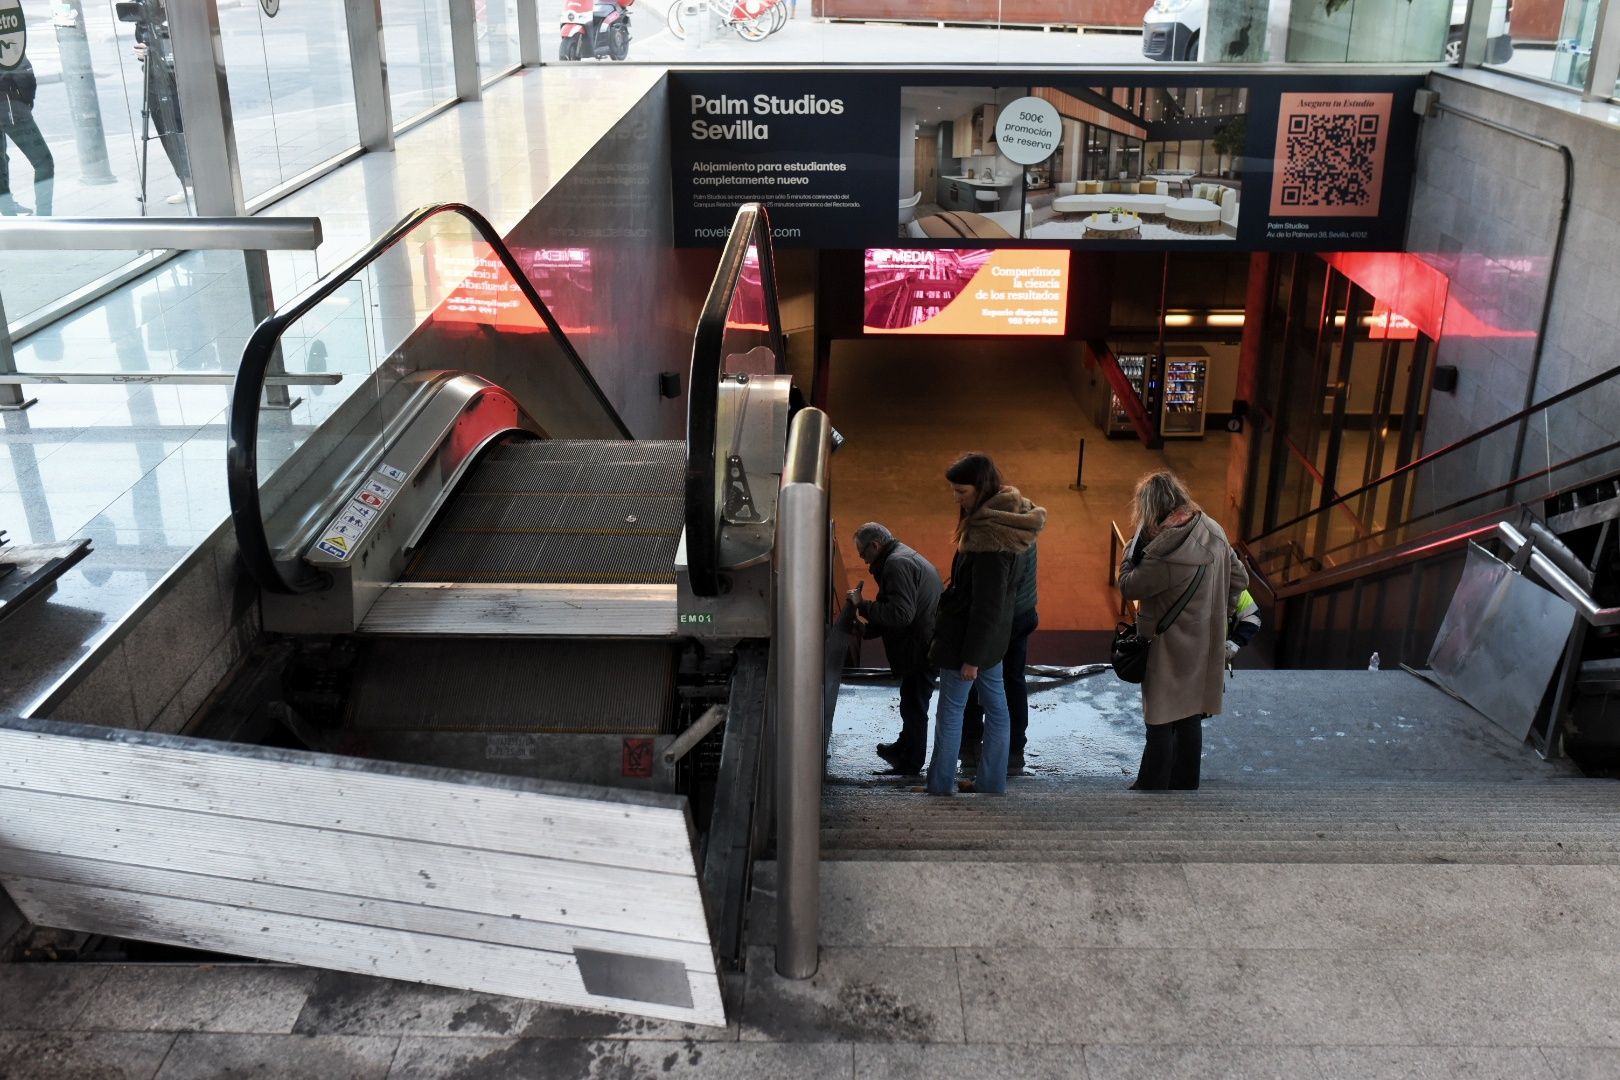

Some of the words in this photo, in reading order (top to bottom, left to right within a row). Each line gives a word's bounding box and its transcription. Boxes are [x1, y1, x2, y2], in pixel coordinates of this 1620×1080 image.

[0, 14, 18, 30] tro
[691, 94, 748, 115] Palm
[753, 94, 844, 115] Studios
[1298, 99, 1331, 108] Asegura
[1343, 99, 1374, 107] Estudio
[1019, 112, 1044, 123] 500€
[691, 119, 769, 140] Sevilla
[1005, 123, 1052, 137] promoción
[1002, 135, 1014, 143] de
[1017, 138, 1052, 150] reserva
[692, 162, 755, 173] Alojamiento
[757, 163, 782, 173] para
[784, 161, 846, 171] estudiantes
[692, 176, 775, 186] completamente
[991, 266, 1061, 277] Compartimos
[1013, 277, 1022, 288] la
[1024, 278, 1060, 288] ciencia
[975, 289, 988, 300] de
[990, 289, 1005, 300] los
[1007, 289, 1060, 300] resultados
